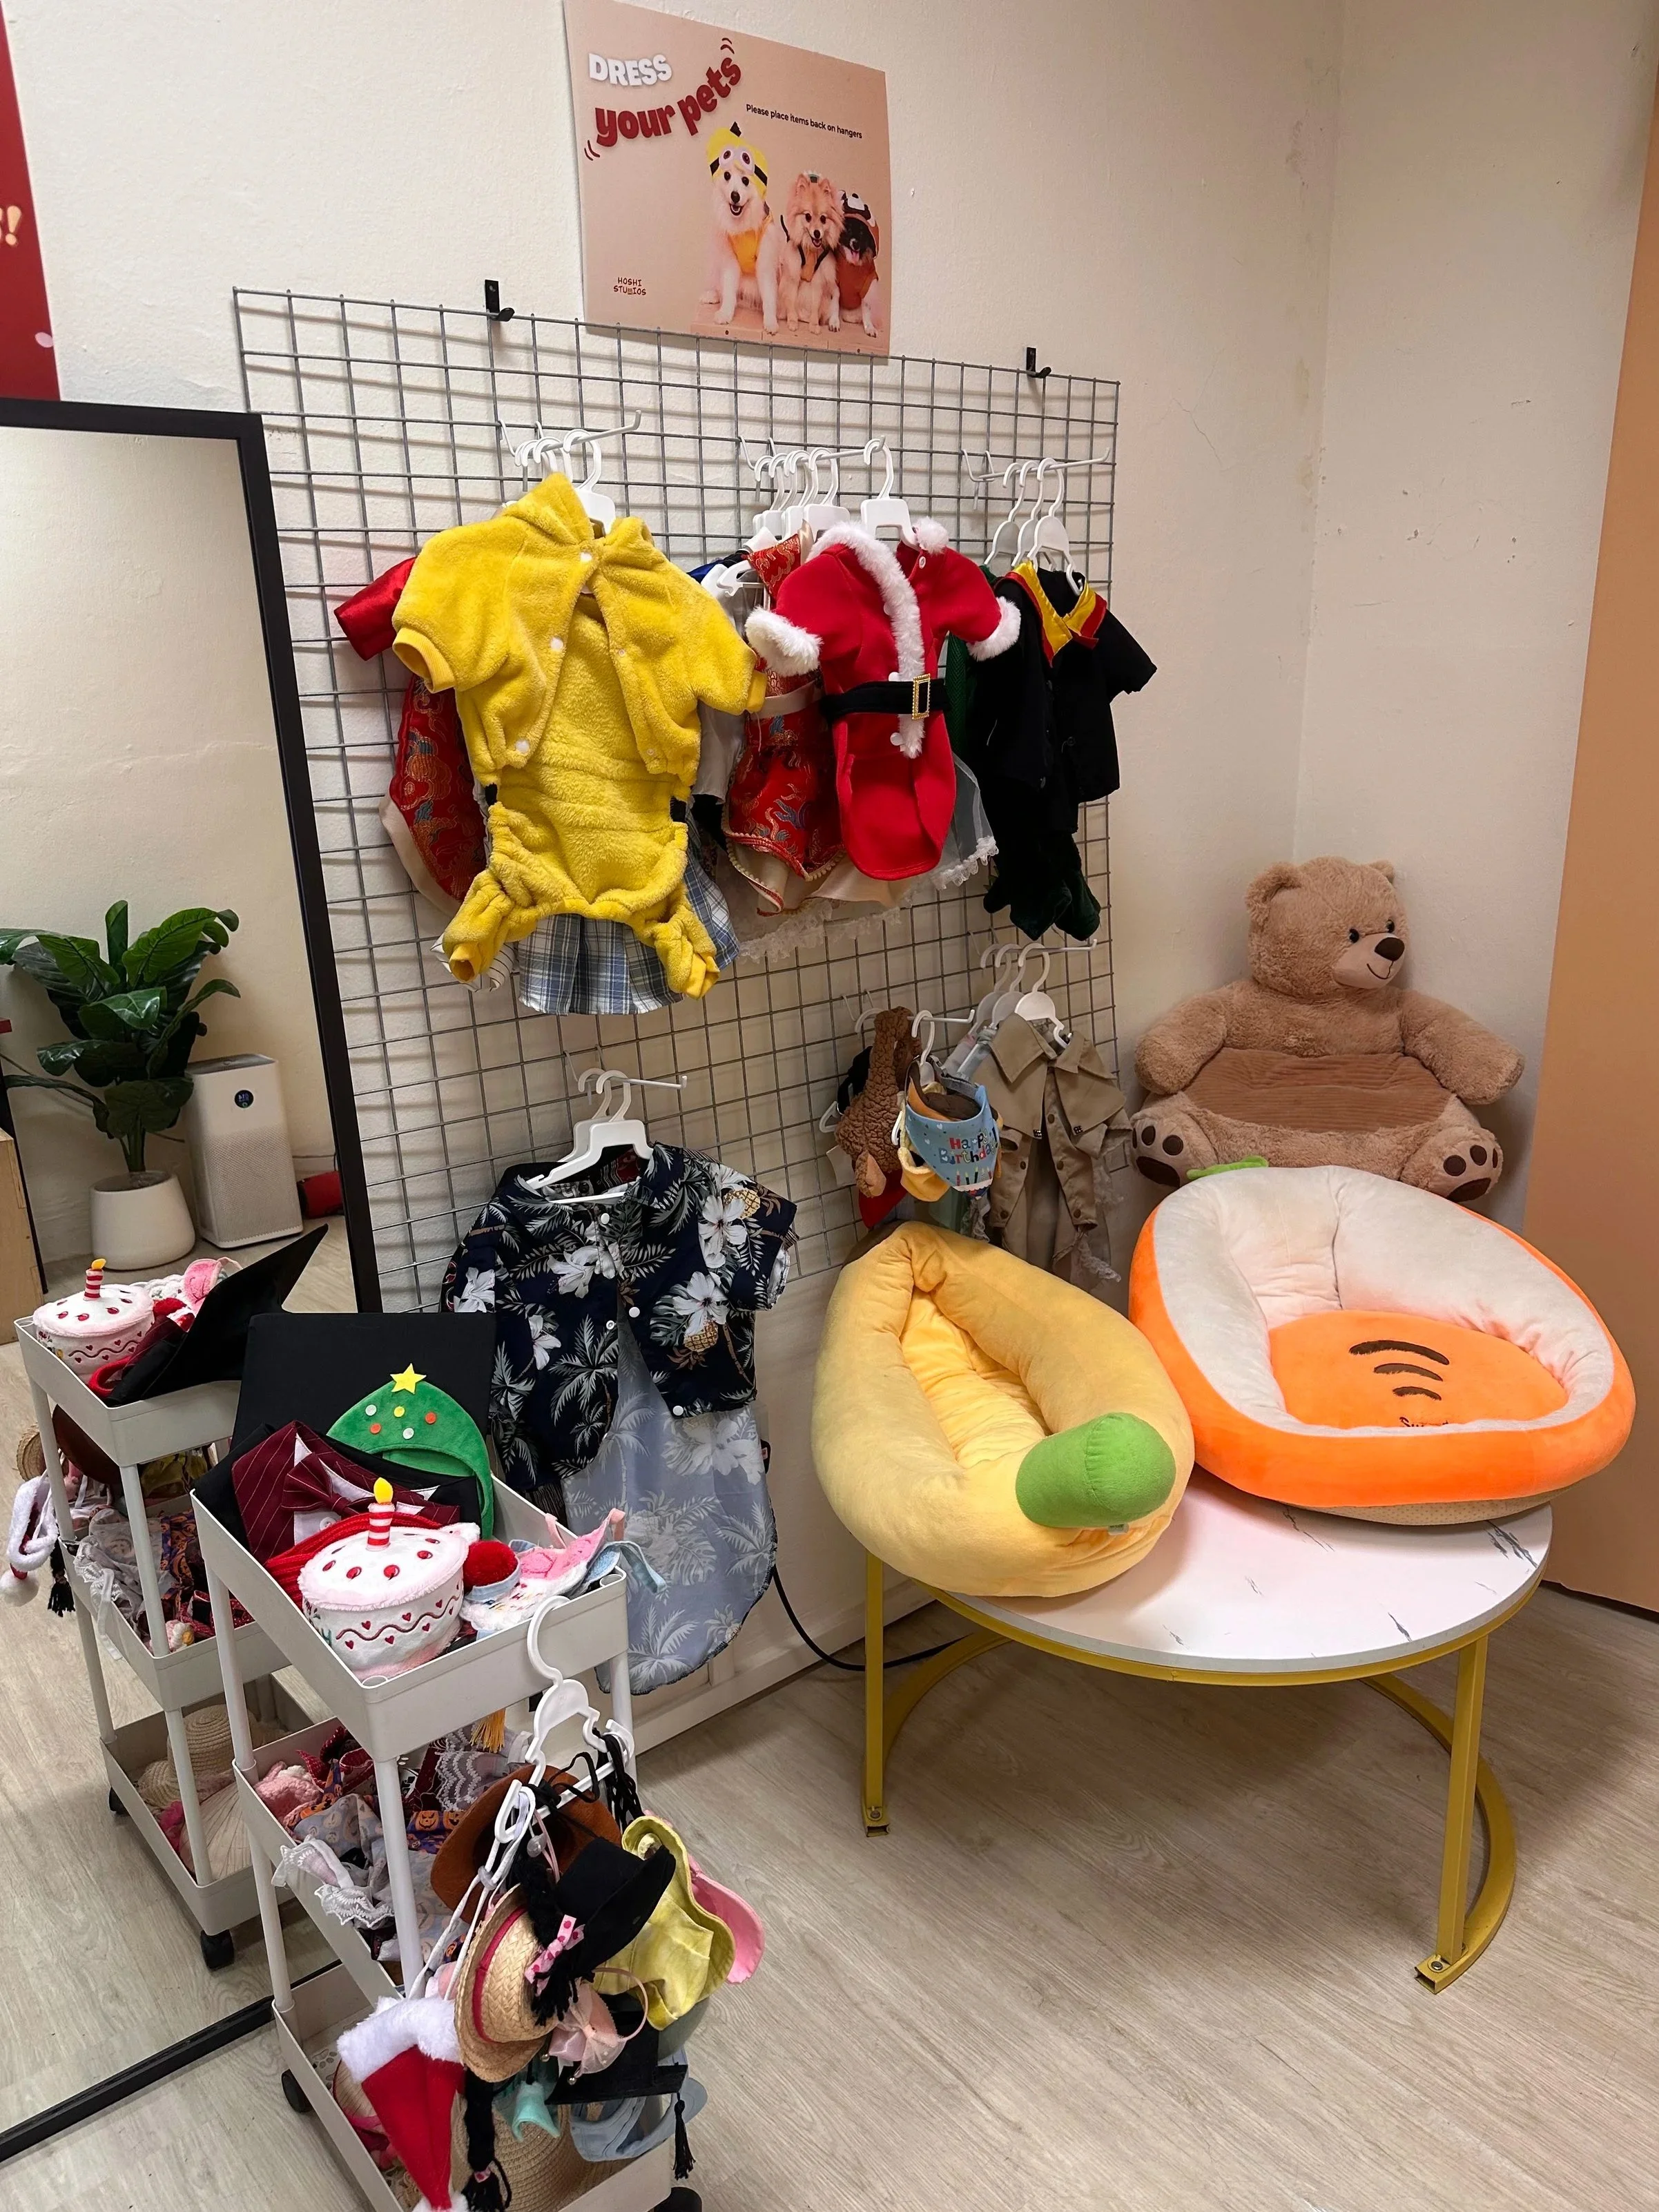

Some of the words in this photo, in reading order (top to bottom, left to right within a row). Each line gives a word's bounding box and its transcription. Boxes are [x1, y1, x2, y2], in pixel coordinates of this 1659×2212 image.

[588, 53, 672, 86] DRESS
[595, 105, 676, 147] your
[677, 57, 741, 136] pets
[746, 104, 769, 115] Please
[770, 110, 789, 121] place
[790, 113, 809, 125] items
[810, 118, 826, 130] back
[837, 125, 862, 139] hangers
[613, 285, 647, 295] STUIOS
[618, 277, 642, 287] HOSHI
[949, 1127, 989, 1149] Happy
